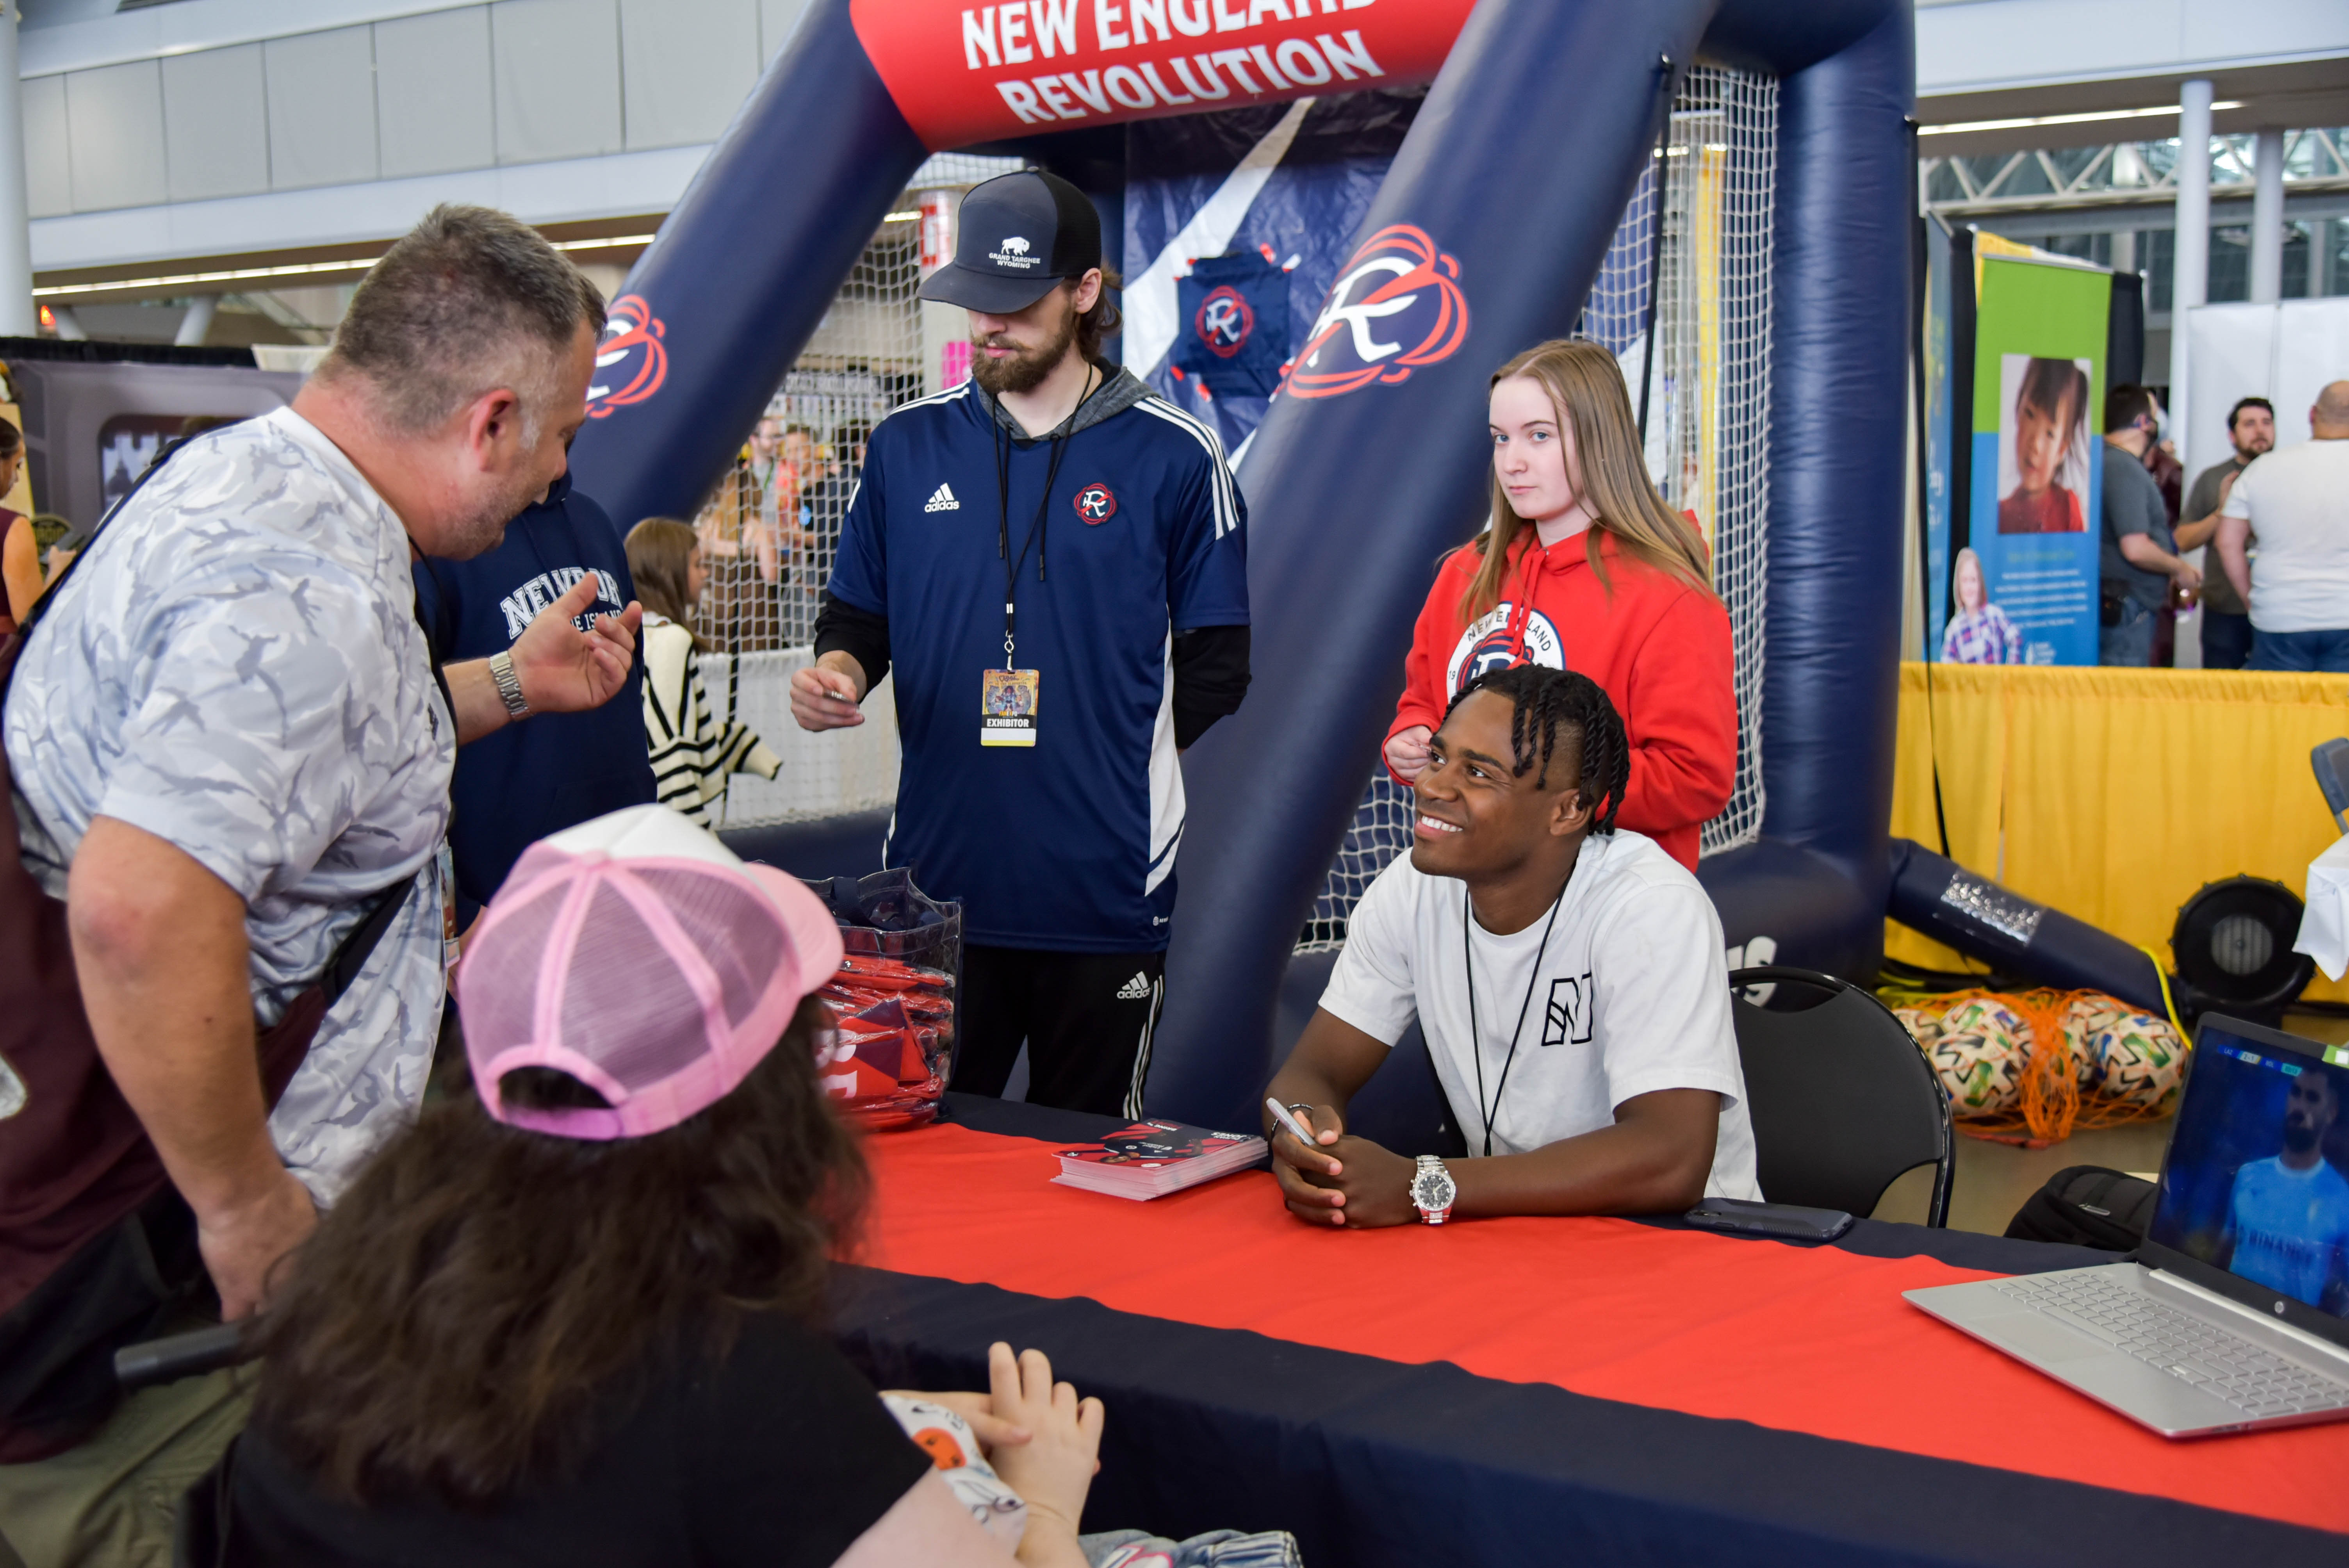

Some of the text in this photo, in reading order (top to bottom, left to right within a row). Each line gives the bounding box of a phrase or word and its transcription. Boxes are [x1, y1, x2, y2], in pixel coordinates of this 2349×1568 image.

[961, 0, 1376, 70] NEW ENGL
[994, 30, 1385, 124] REVOLUTION
[989, 253, 1011, 261] GRAND
[997, 260, 1030, 269] WYOMING
[925, 500, 959, 513] adidas
[500, 567, 623, 640] NEWPOR
[1496, 611, 1551, 651] ELAND
[1448, 670, 1456, 680] 19
[987, 718, 1029, 727] EXHIBITOR
[1117, 987, 1150, 999] adidas
